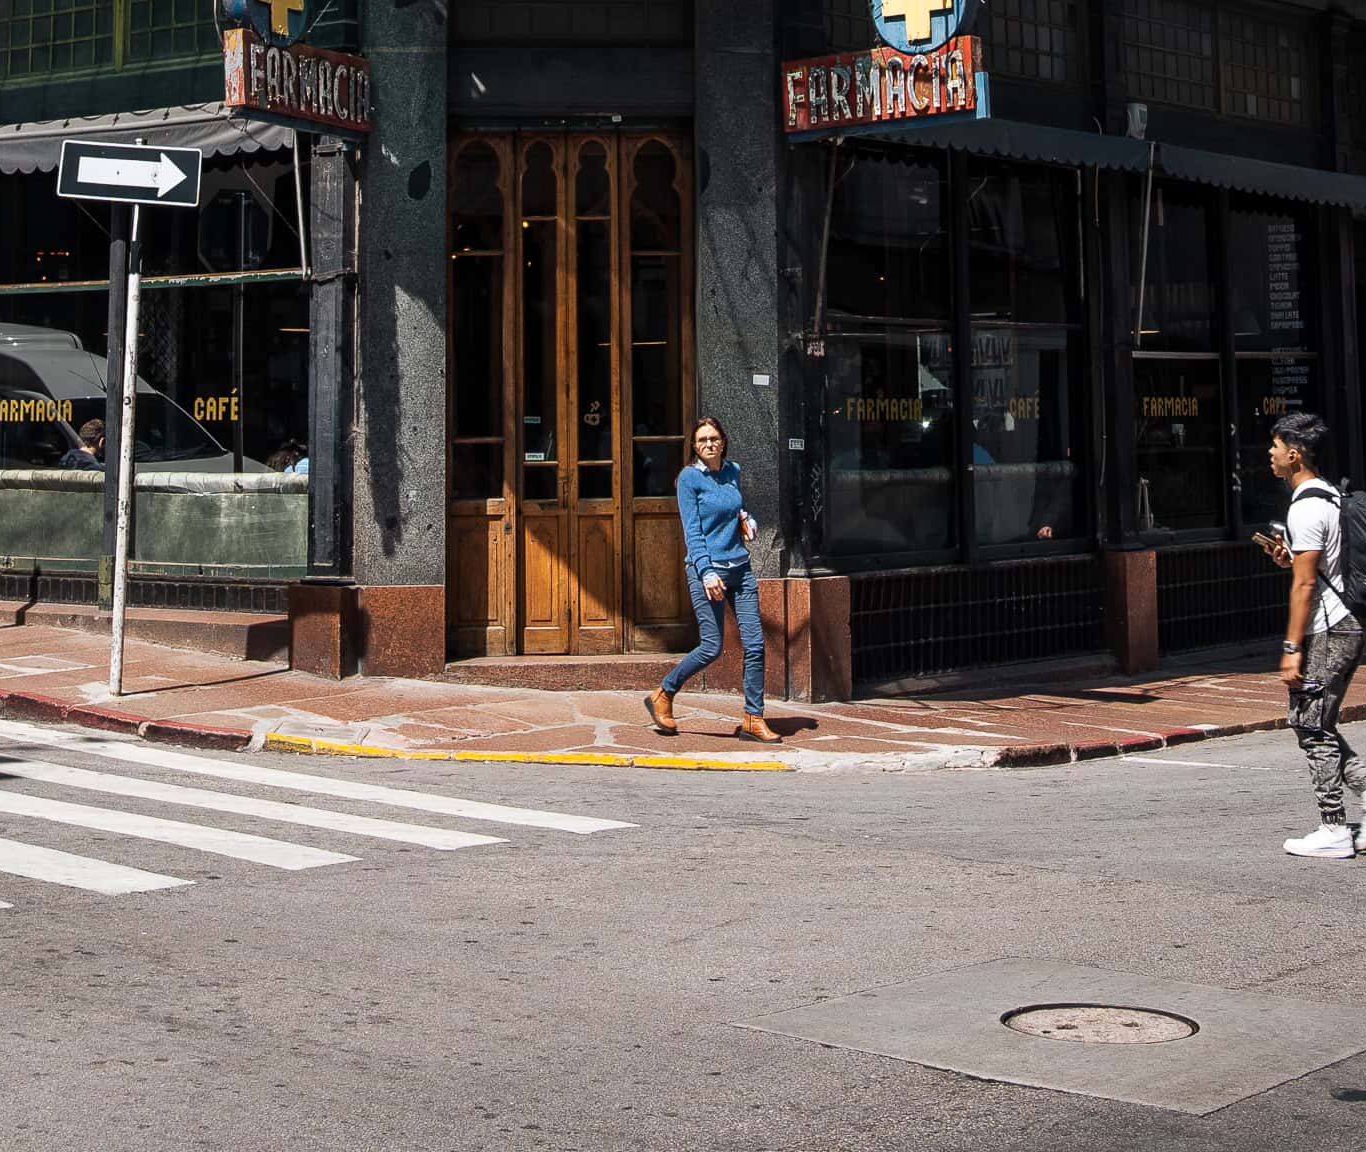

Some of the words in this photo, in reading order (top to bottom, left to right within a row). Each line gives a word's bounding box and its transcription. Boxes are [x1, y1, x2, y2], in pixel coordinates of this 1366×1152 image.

[250, 43, 371, 124] FARMACIA
[785, 49, 966, 126] FARMACIA
[194, 388, 239, 420] CAFÉ
[846, 398, 923, 421] FARMACIA
[1143, 397, 1199, 416] FARMACIA
